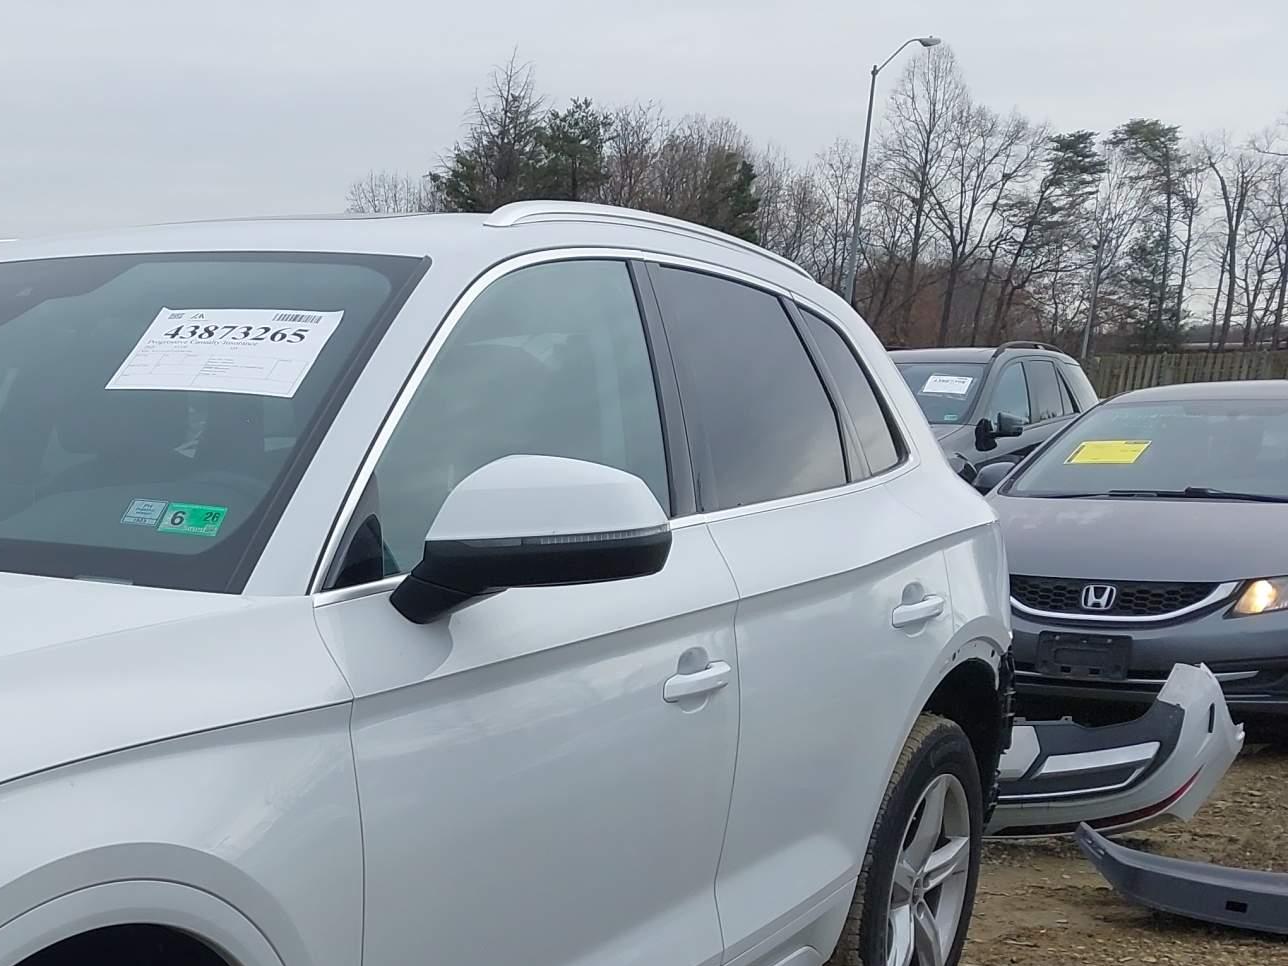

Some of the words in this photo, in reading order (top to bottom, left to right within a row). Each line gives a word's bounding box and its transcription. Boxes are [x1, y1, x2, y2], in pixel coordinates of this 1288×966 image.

[164, 324, 310, 344] 43873265
[170, 511, 186, 526] 6
[204, 511, 221, 523] 26
